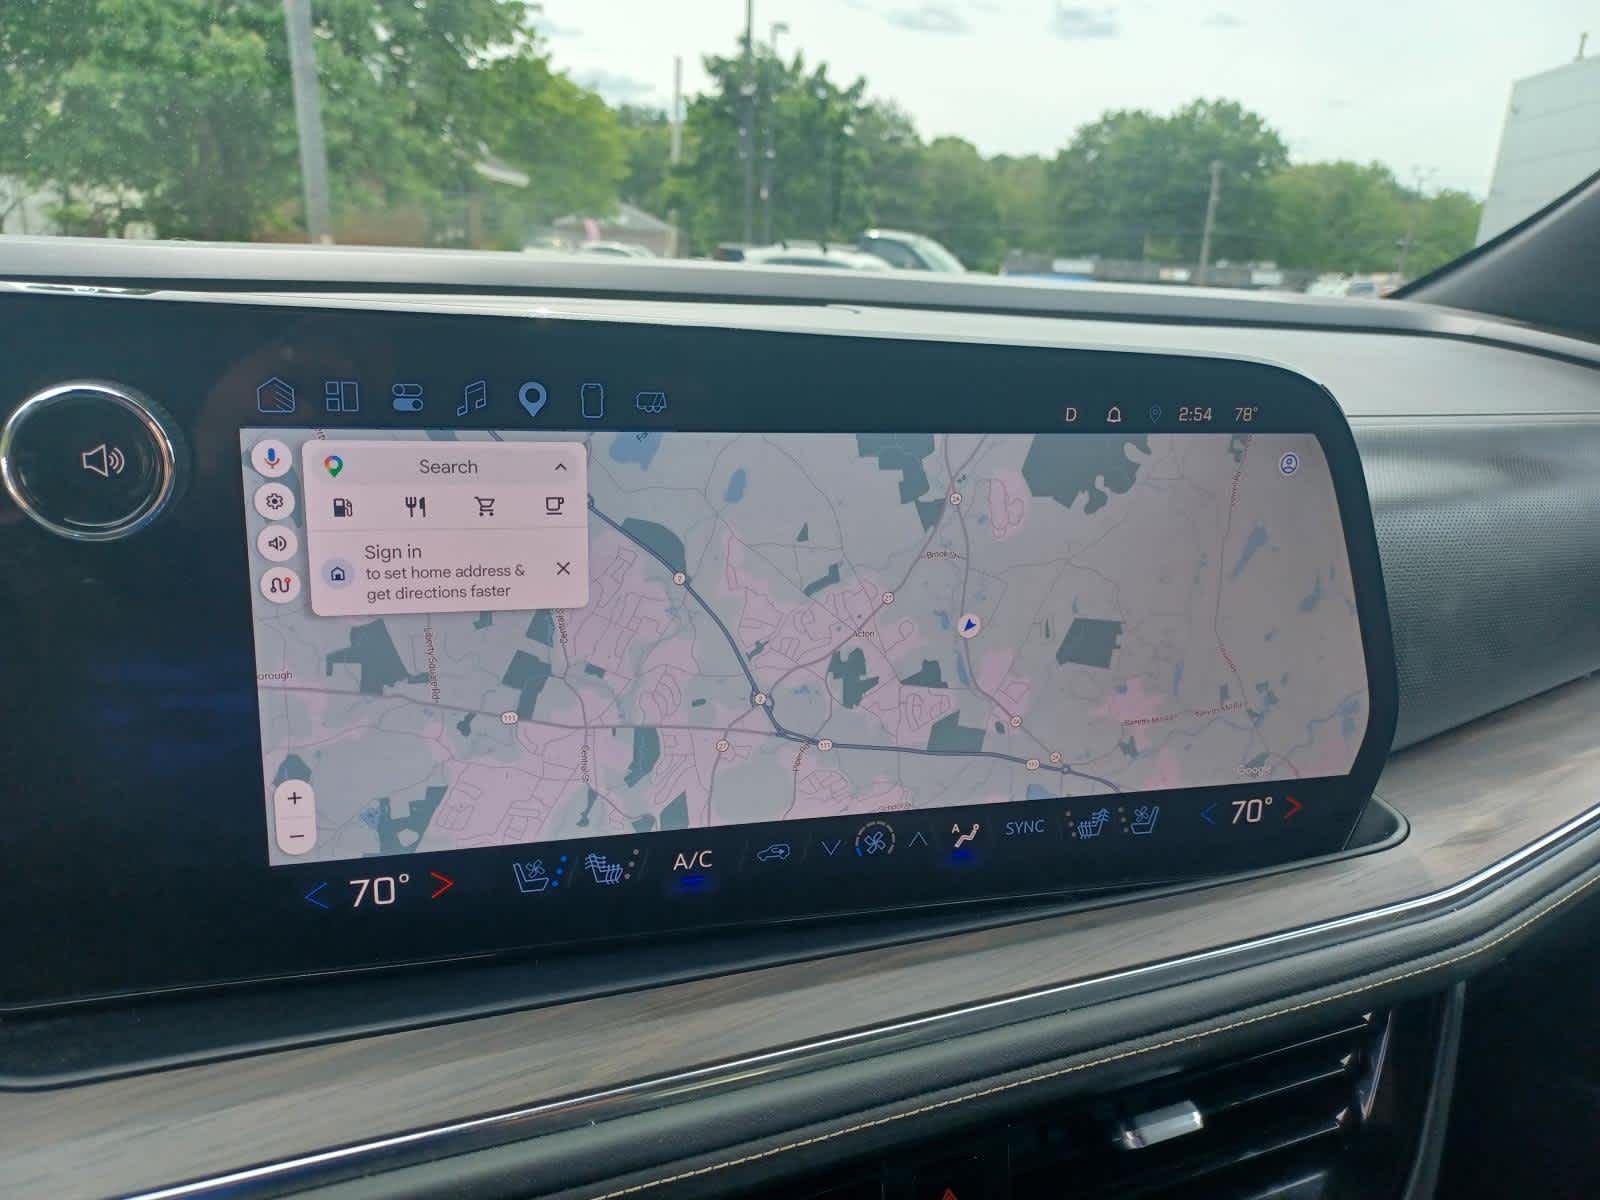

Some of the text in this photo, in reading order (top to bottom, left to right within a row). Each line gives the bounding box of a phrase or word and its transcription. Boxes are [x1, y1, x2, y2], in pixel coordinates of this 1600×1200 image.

[1065, 407, 1077, 422] D
[1178, 407, 1213, 422] 2:54
[1235, 407, 1258, 422] 78°
[419, 459, 479, 475] Search
[364, 543, 422, 563] Sign in
[366, 564, 526, 580] to set home address &
[366, 585, 511, 603] get directions faster
[853, 630, 875, 638] Acton
[256, 670, 293, 682] orough
[1231, 796, 1273, 825] 70°
[951, 823, 960, 834] A
[1005, 819, 1046, 836] SYNC
[672, 850, 713, 872] A/C
[348, 873, 410, 908] 70°
